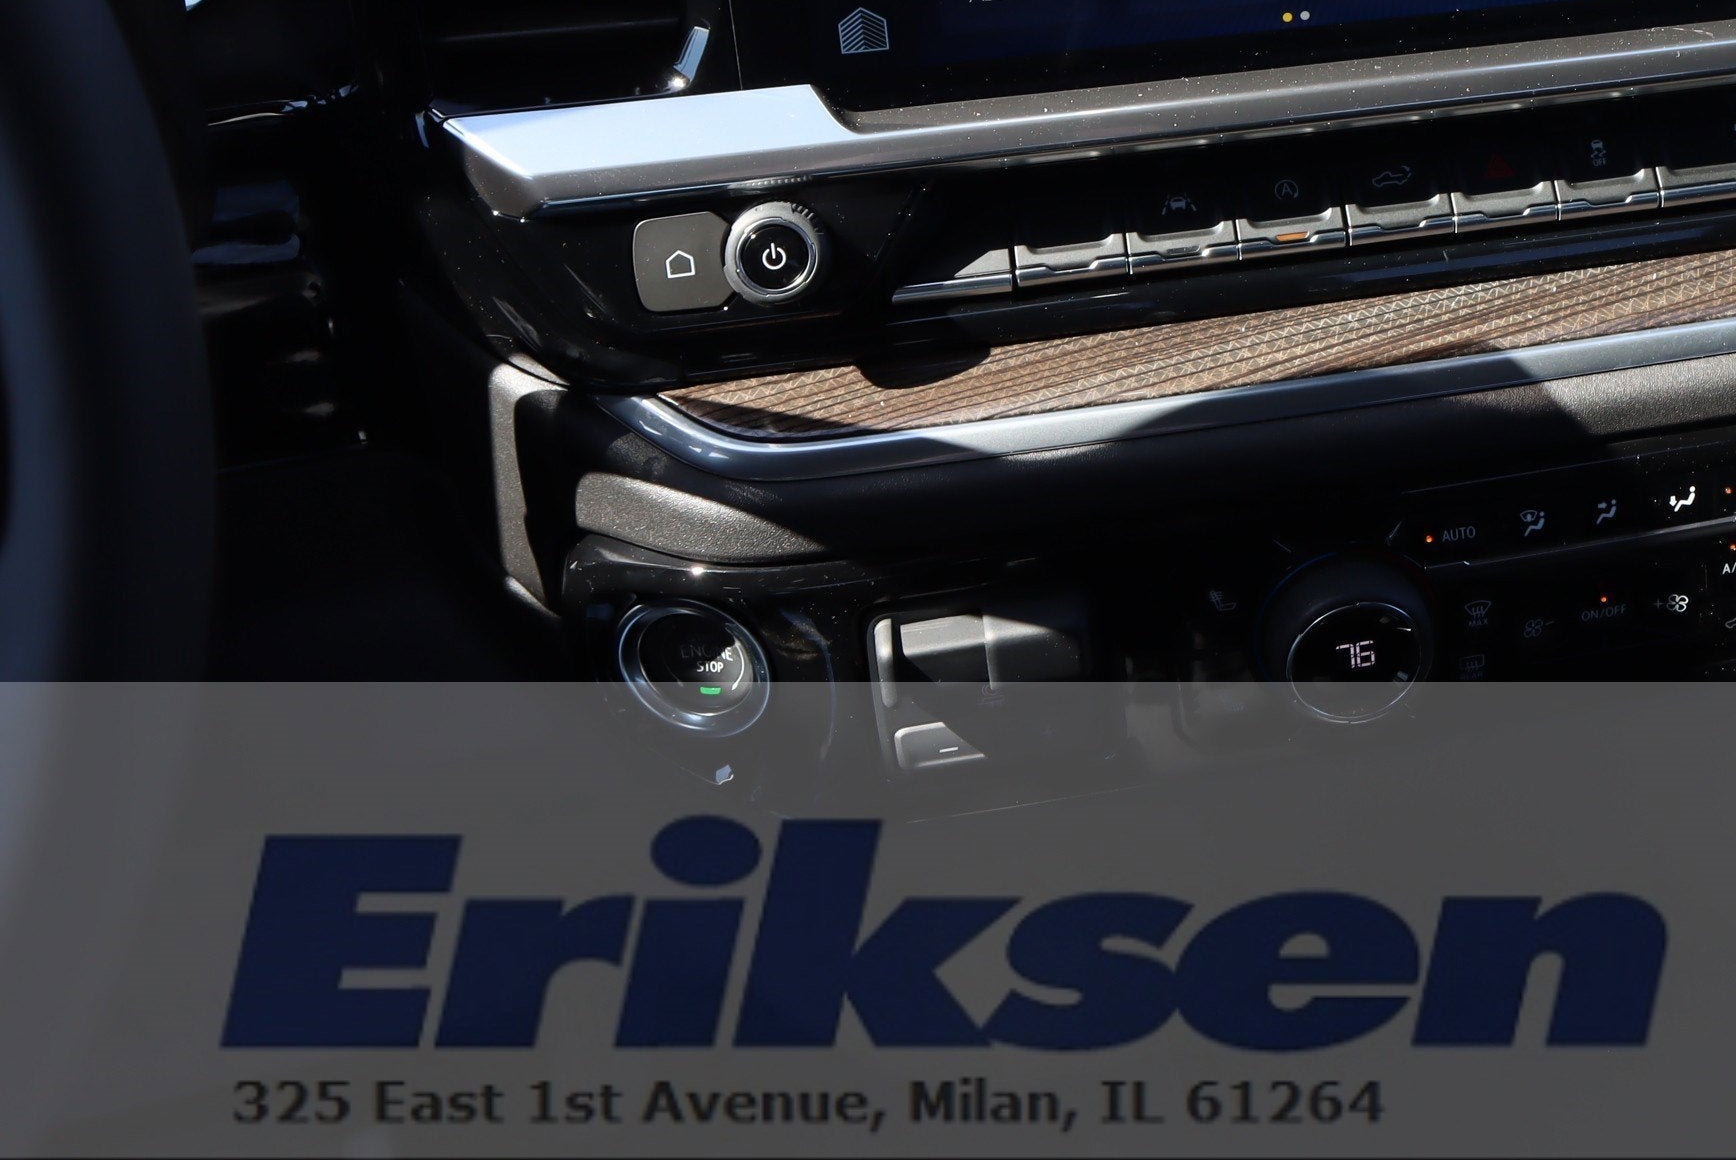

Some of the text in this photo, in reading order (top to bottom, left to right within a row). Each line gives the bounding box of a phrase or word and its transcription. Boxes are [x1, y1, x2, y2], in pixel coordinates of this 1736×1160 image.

[1442, 525, 1476, 542] AUTO
[1580, 604, 1627, 622] ON/OFF
[681, 646, 733, 662] ENGNE
[1335, 640, 1376, 669] 76
[696, 660, 724, 673] STOP
